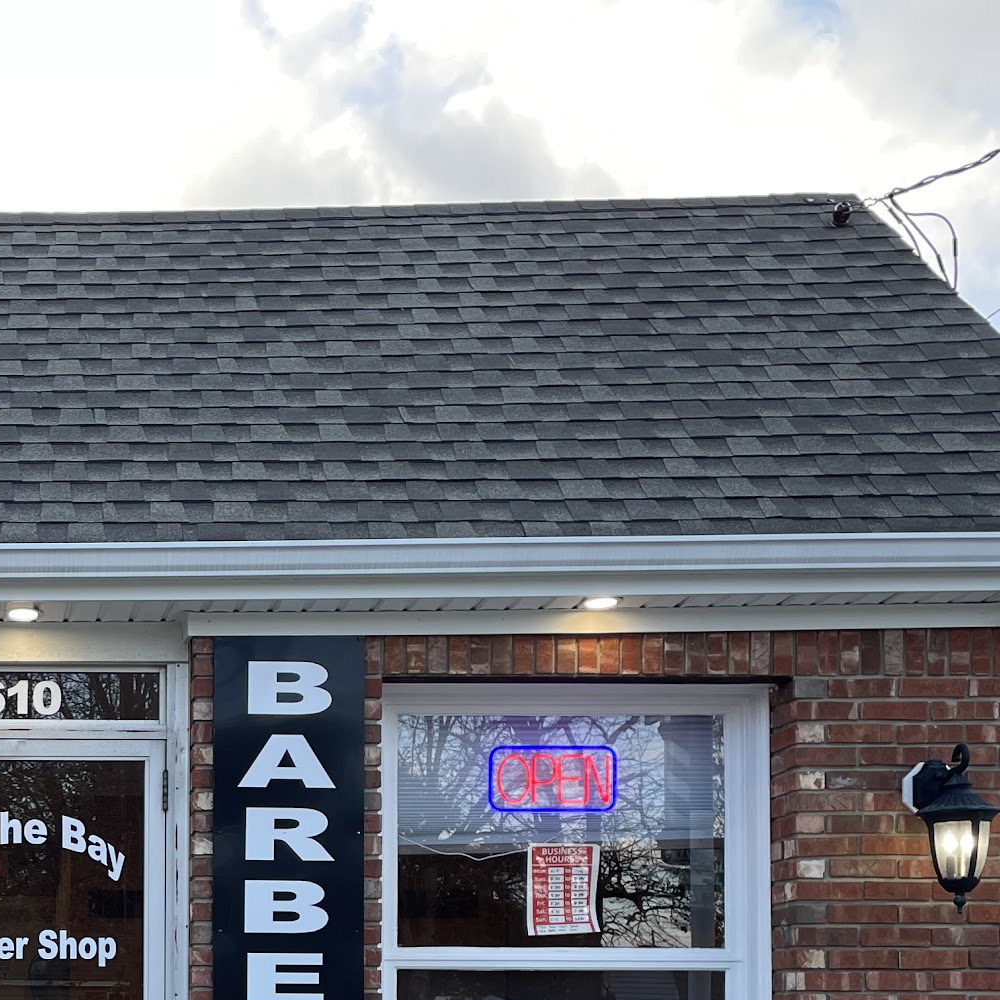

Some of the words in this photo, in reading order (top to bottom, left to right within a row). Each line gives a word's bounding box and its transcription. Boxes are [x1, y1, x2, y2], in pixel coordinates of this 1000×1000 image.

[496, 753, 611, 805] OPEN
[61, 815, 126, 882] Bay
[542, 847, 583, 856] BUSINESS
[545, 855, 575, 864] HOURS
[37, 929, 117, 967] Shop
